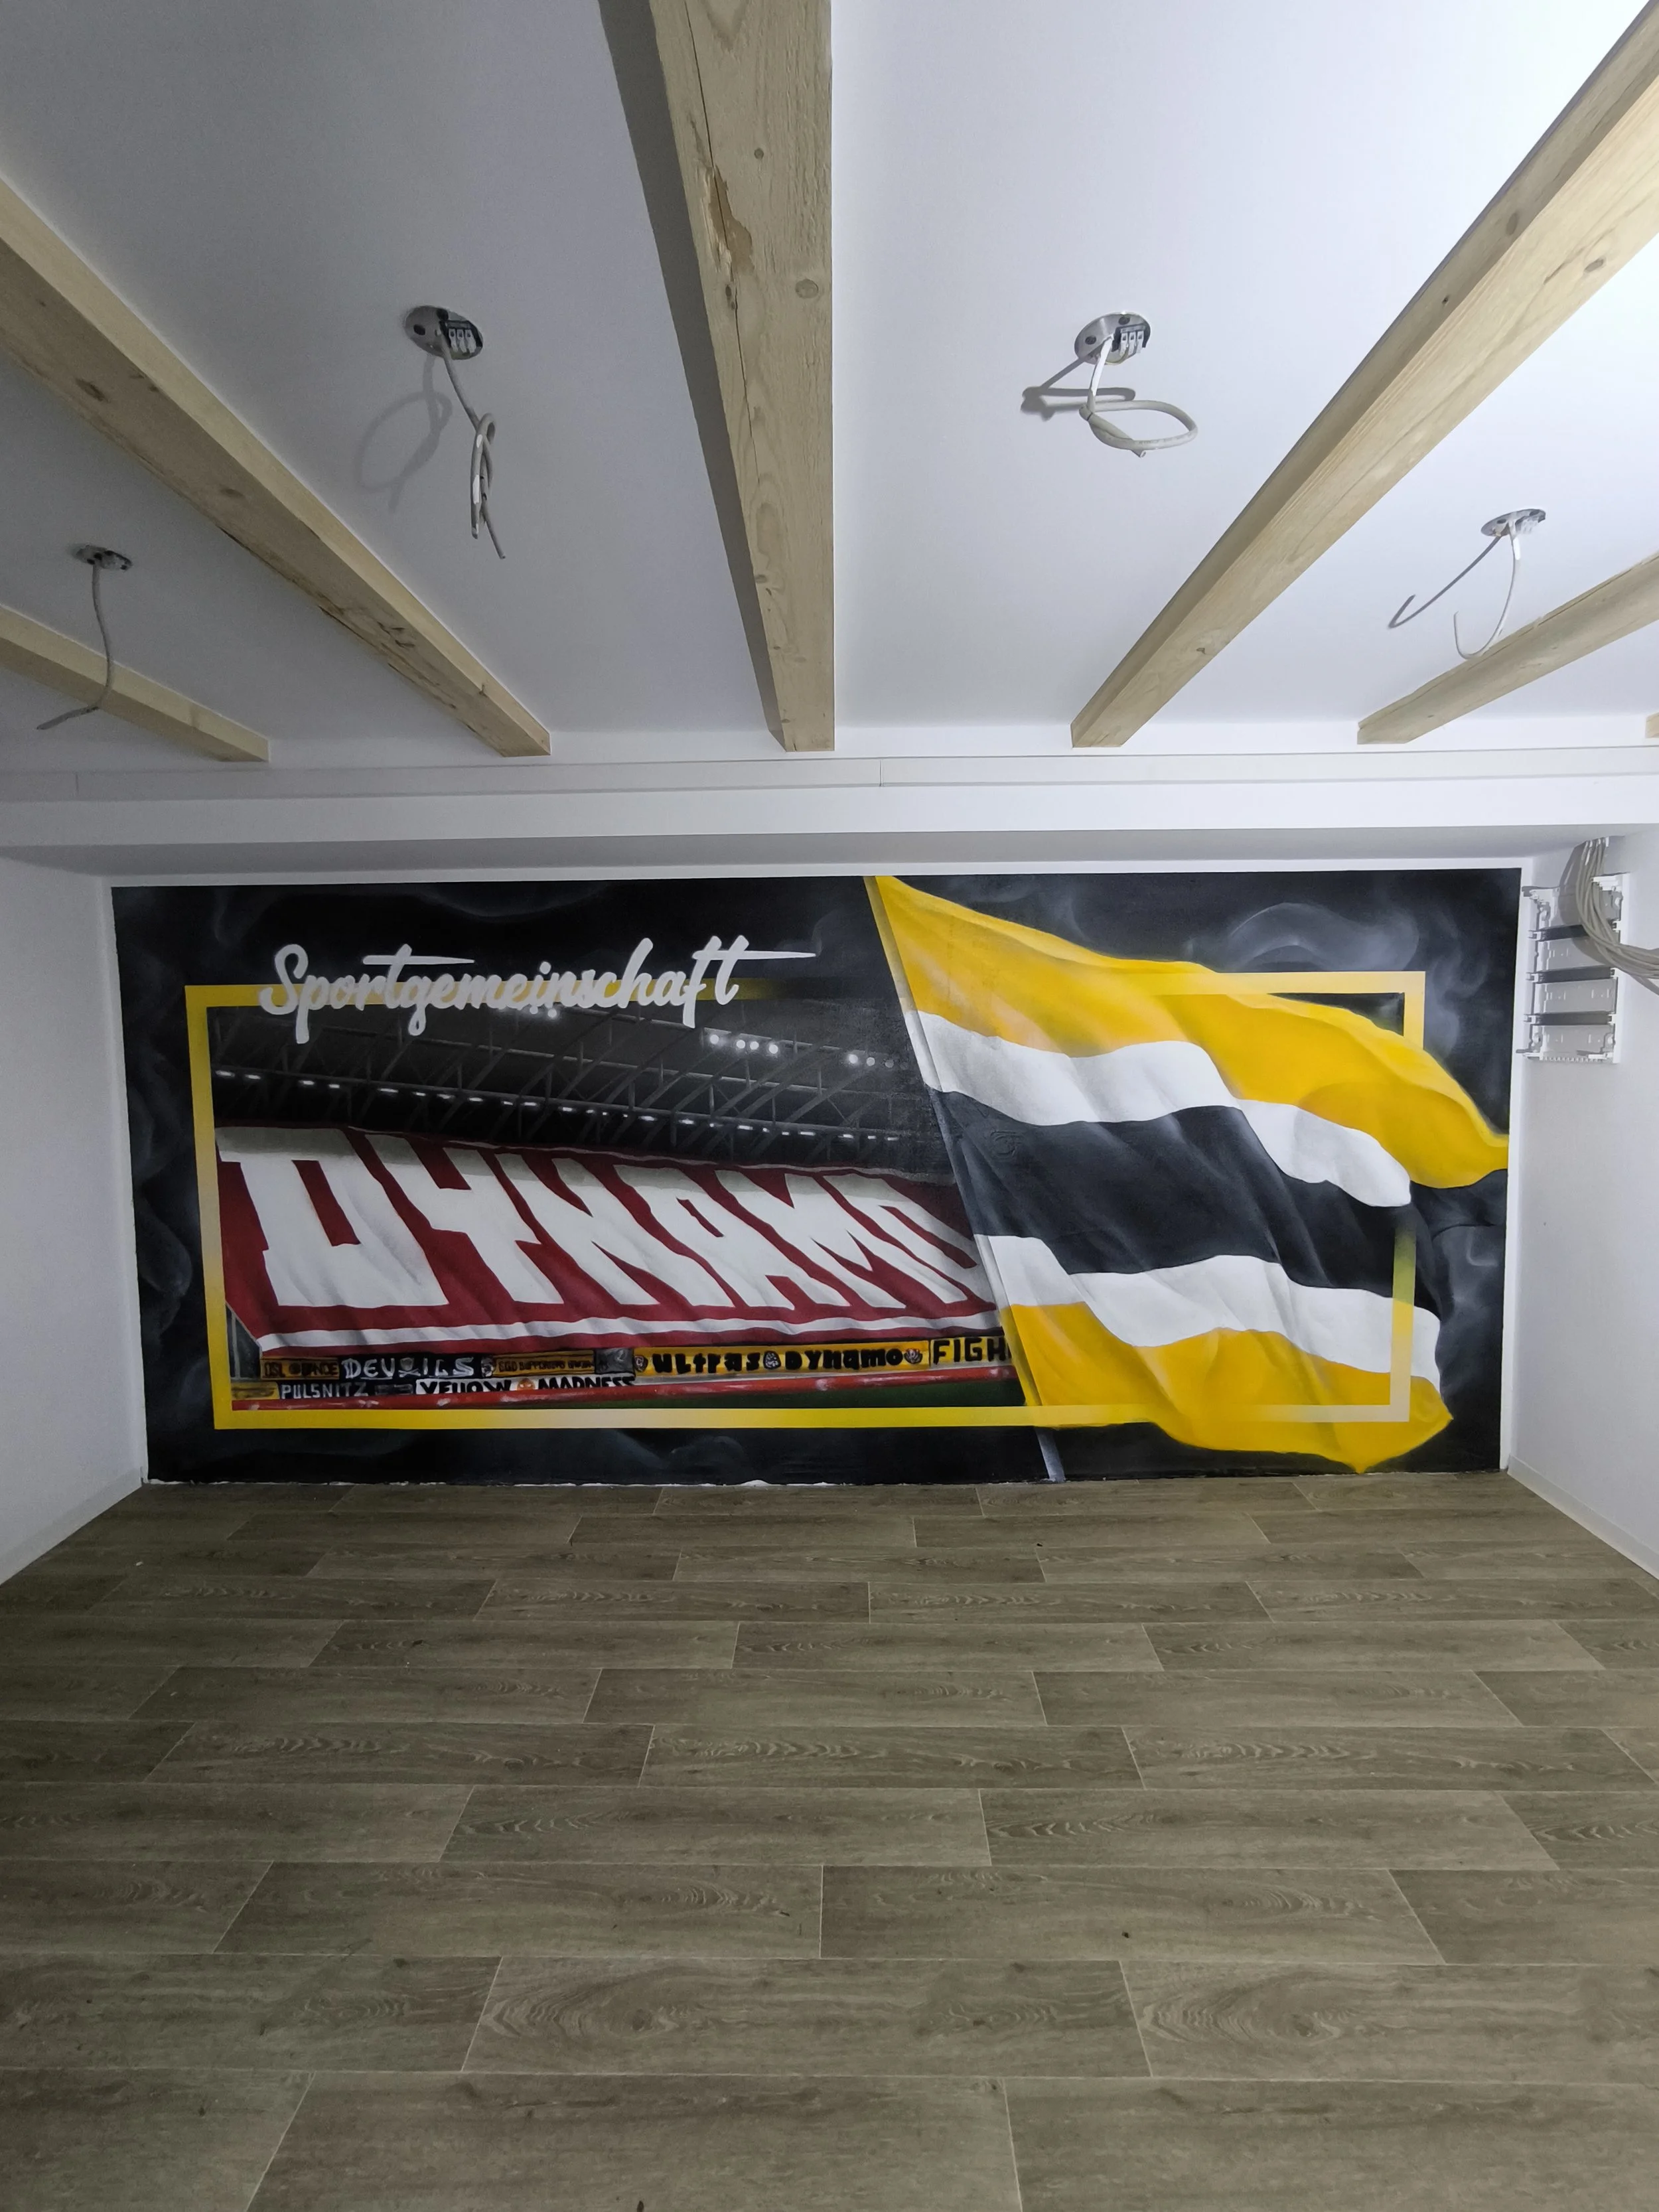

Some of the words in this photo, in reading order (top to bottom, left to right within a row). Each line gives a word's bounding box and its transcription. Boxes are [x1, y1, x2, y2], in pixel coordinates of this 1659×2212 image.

[260, 935, 816, 1044] Sportgemeinschaft
[216, 1126, 996, 1309] DYNAMO
[933, 1337, 1012, 1365] FIGH
[281, 1382, 368, 1399] PULSNITZ
